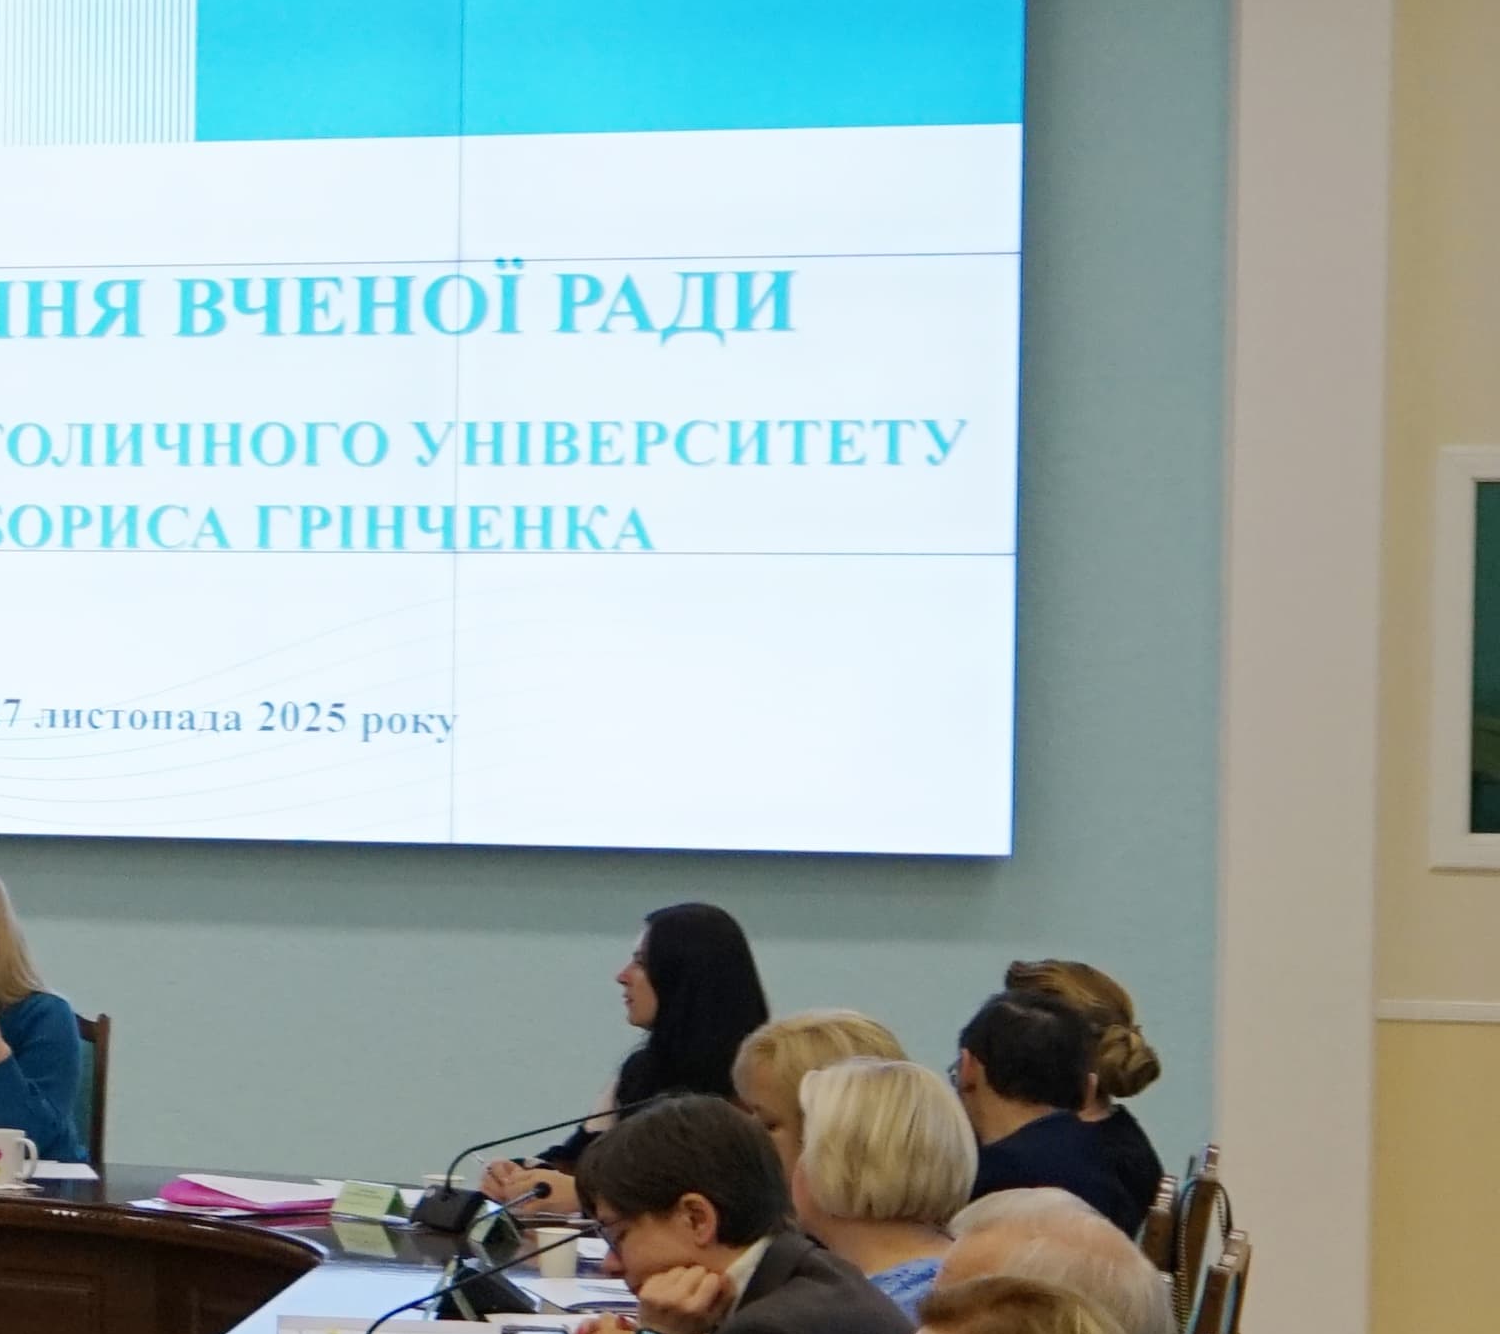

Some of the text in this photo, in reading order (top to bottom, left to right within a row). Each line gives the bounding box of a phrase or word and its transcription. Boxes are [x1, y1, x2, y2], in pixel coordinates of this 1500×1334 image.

[172, 257, 526, 339] ВЧЕНОЇ
[554, 270, 798, 347] РАДИ
[411, 419, 970, 468] УНІВЕРСИТЕТУ
[255, 505, 657, 552] ГРІНЧЕНКА
[35, 708, 242, 733] листопада
[258, 701, 347, 733] 2025
[362, 713, 457, 743] року
